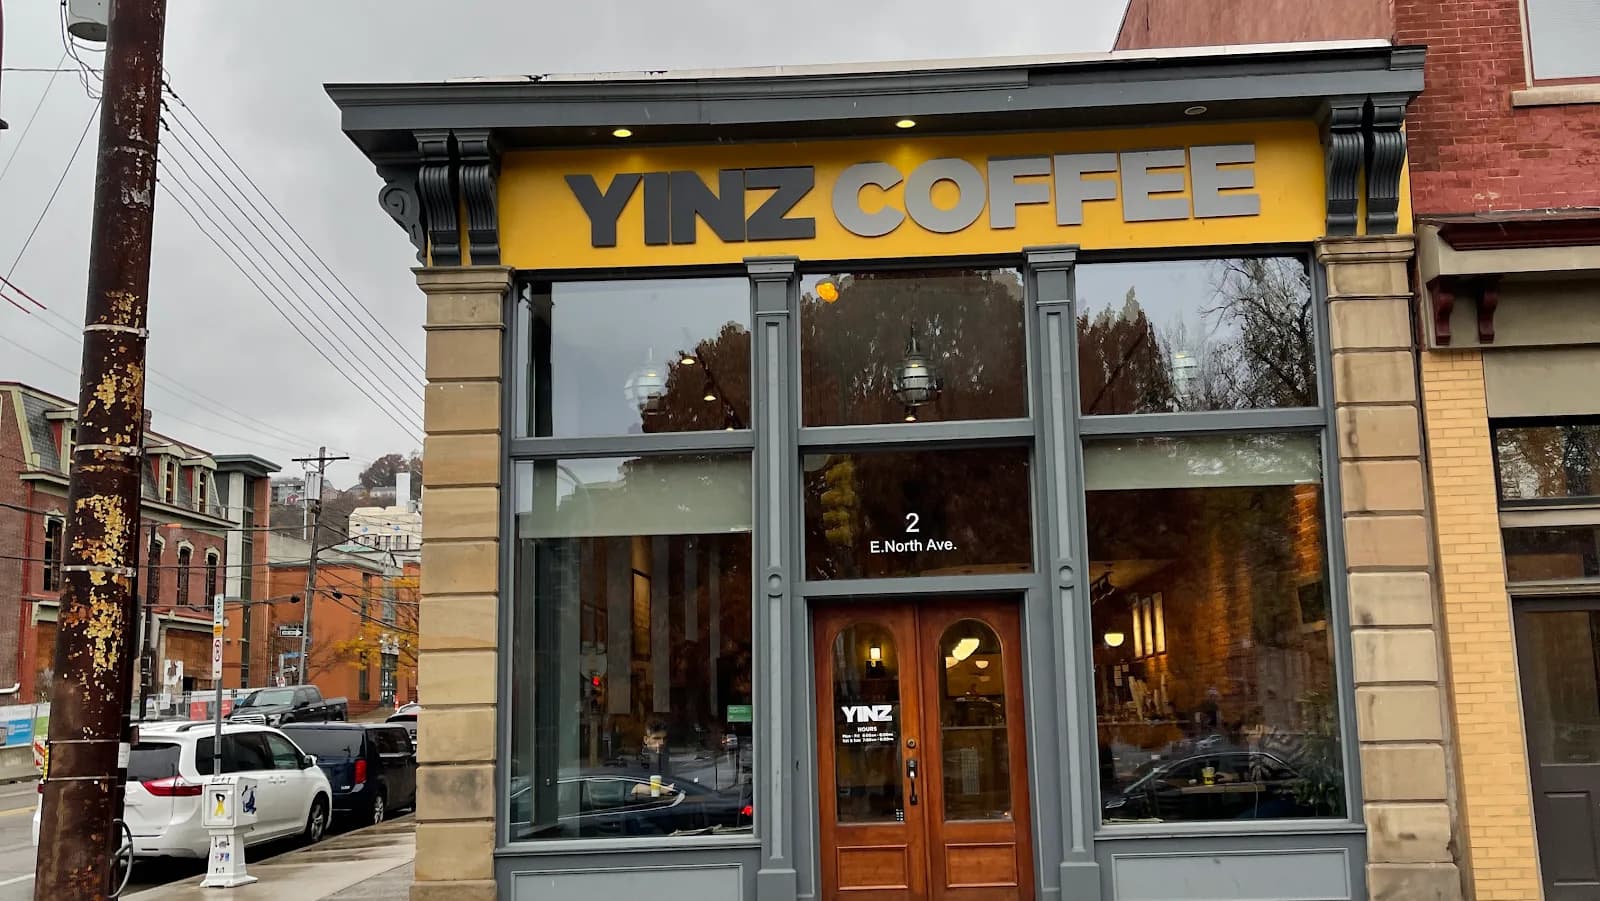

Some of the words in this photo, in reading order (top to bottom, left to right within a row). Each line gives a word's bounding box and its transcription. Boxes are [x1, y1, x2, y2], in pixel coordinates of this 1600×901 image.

[563, 165, 816, 248] YINZ
[831, 143, 1261, 238] COFFEE
[905, 512, 920, 533] 2
[870, 539, 923, 553] E.North
[926, 538, 957, 551] Ave.
[841, 704, 893, 723] YINZ
